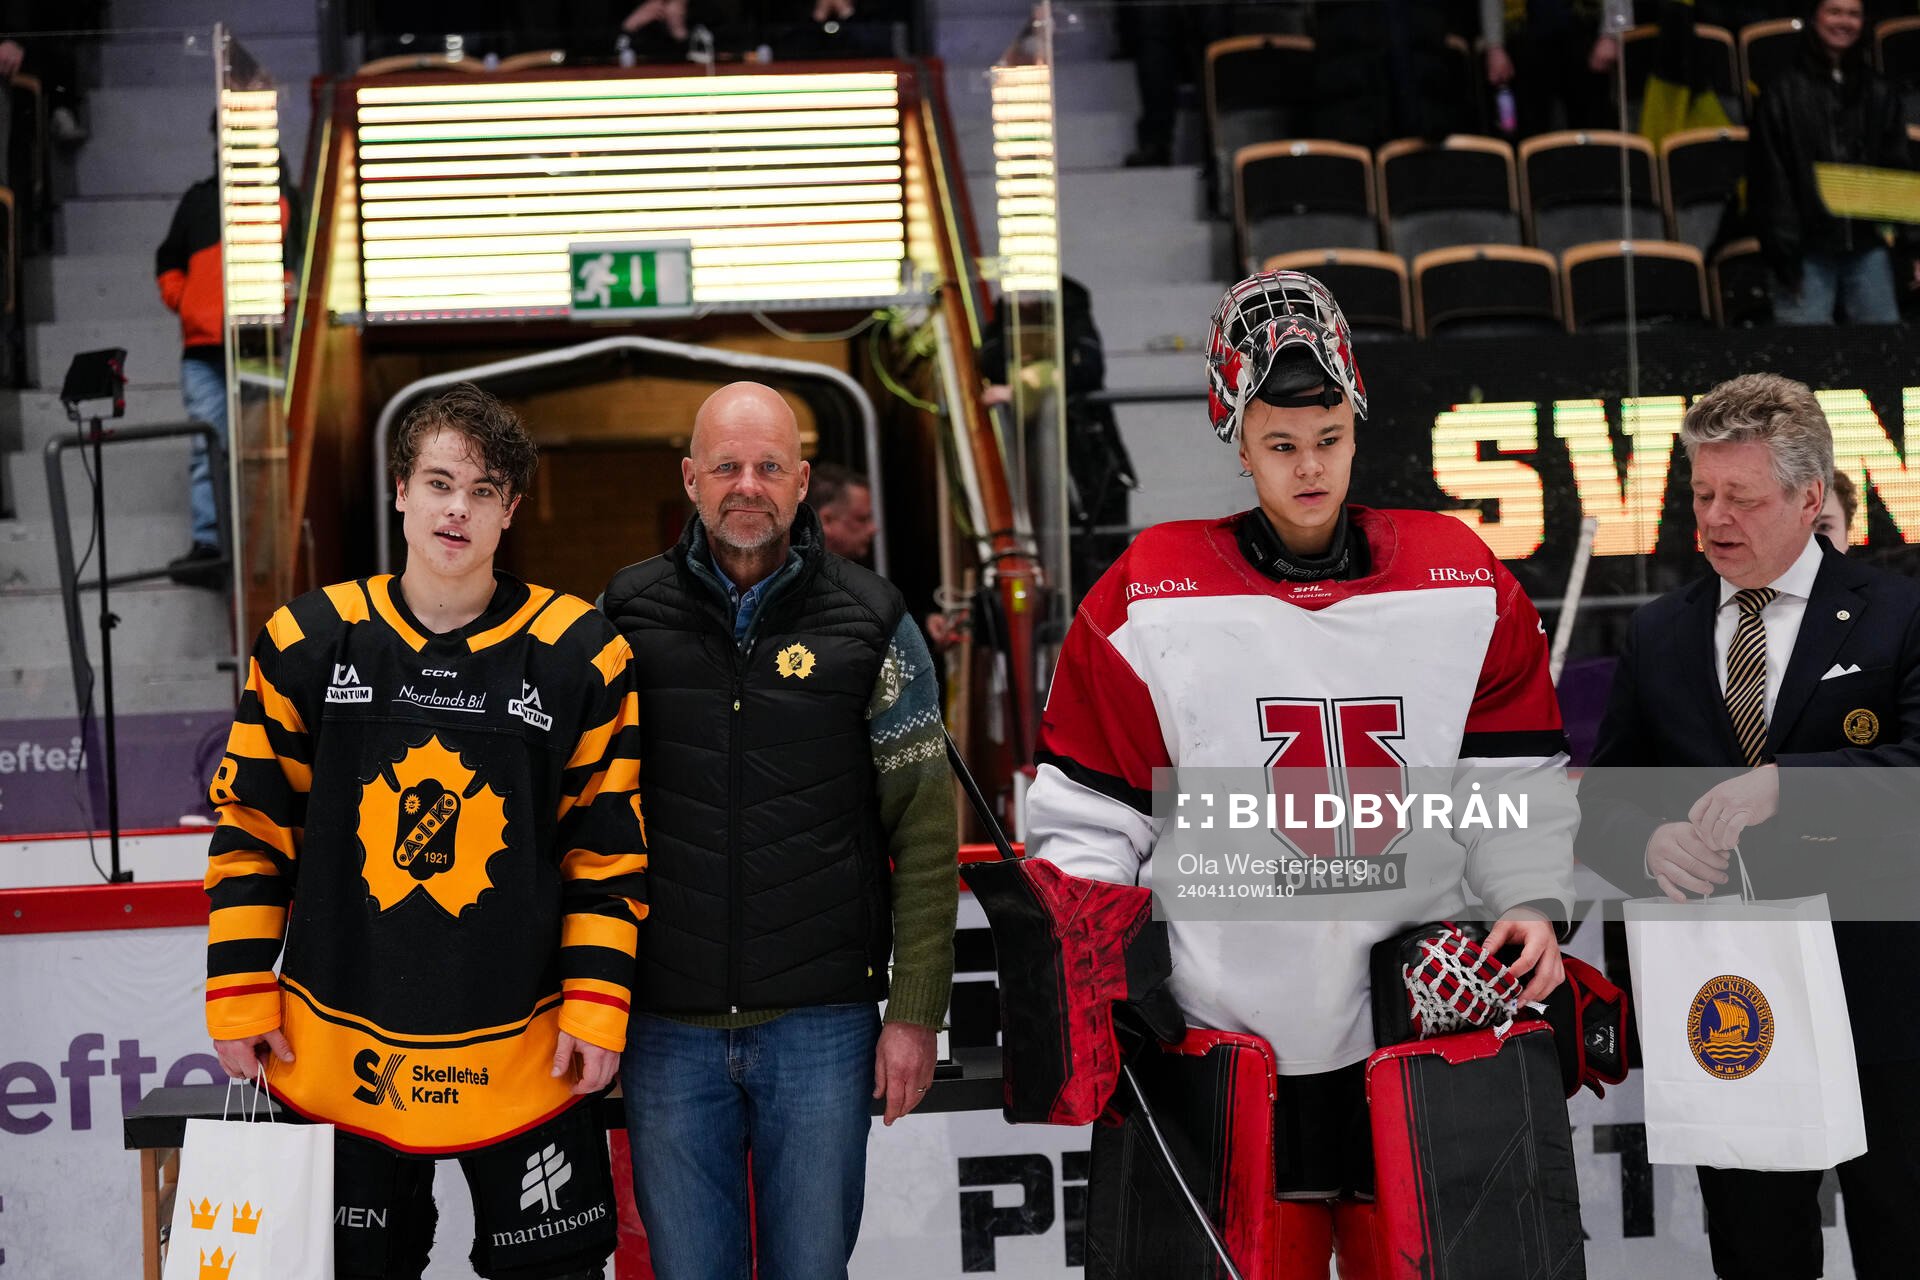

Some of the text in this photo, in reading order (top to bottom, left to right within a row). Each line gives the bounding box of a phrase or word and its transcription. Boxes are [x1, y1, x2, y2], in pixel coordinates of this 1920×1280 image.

[421, 668, 458, 678] CCM
[398, 684, 487, 708] Norrlands Bil
[424, 851, 448, 865] 1921
[412, 1065, 489, 1085] Skellefteå
[411, 1086, 459, 1104] Kraft
[492, 1203, 606, 1247] martinsons
